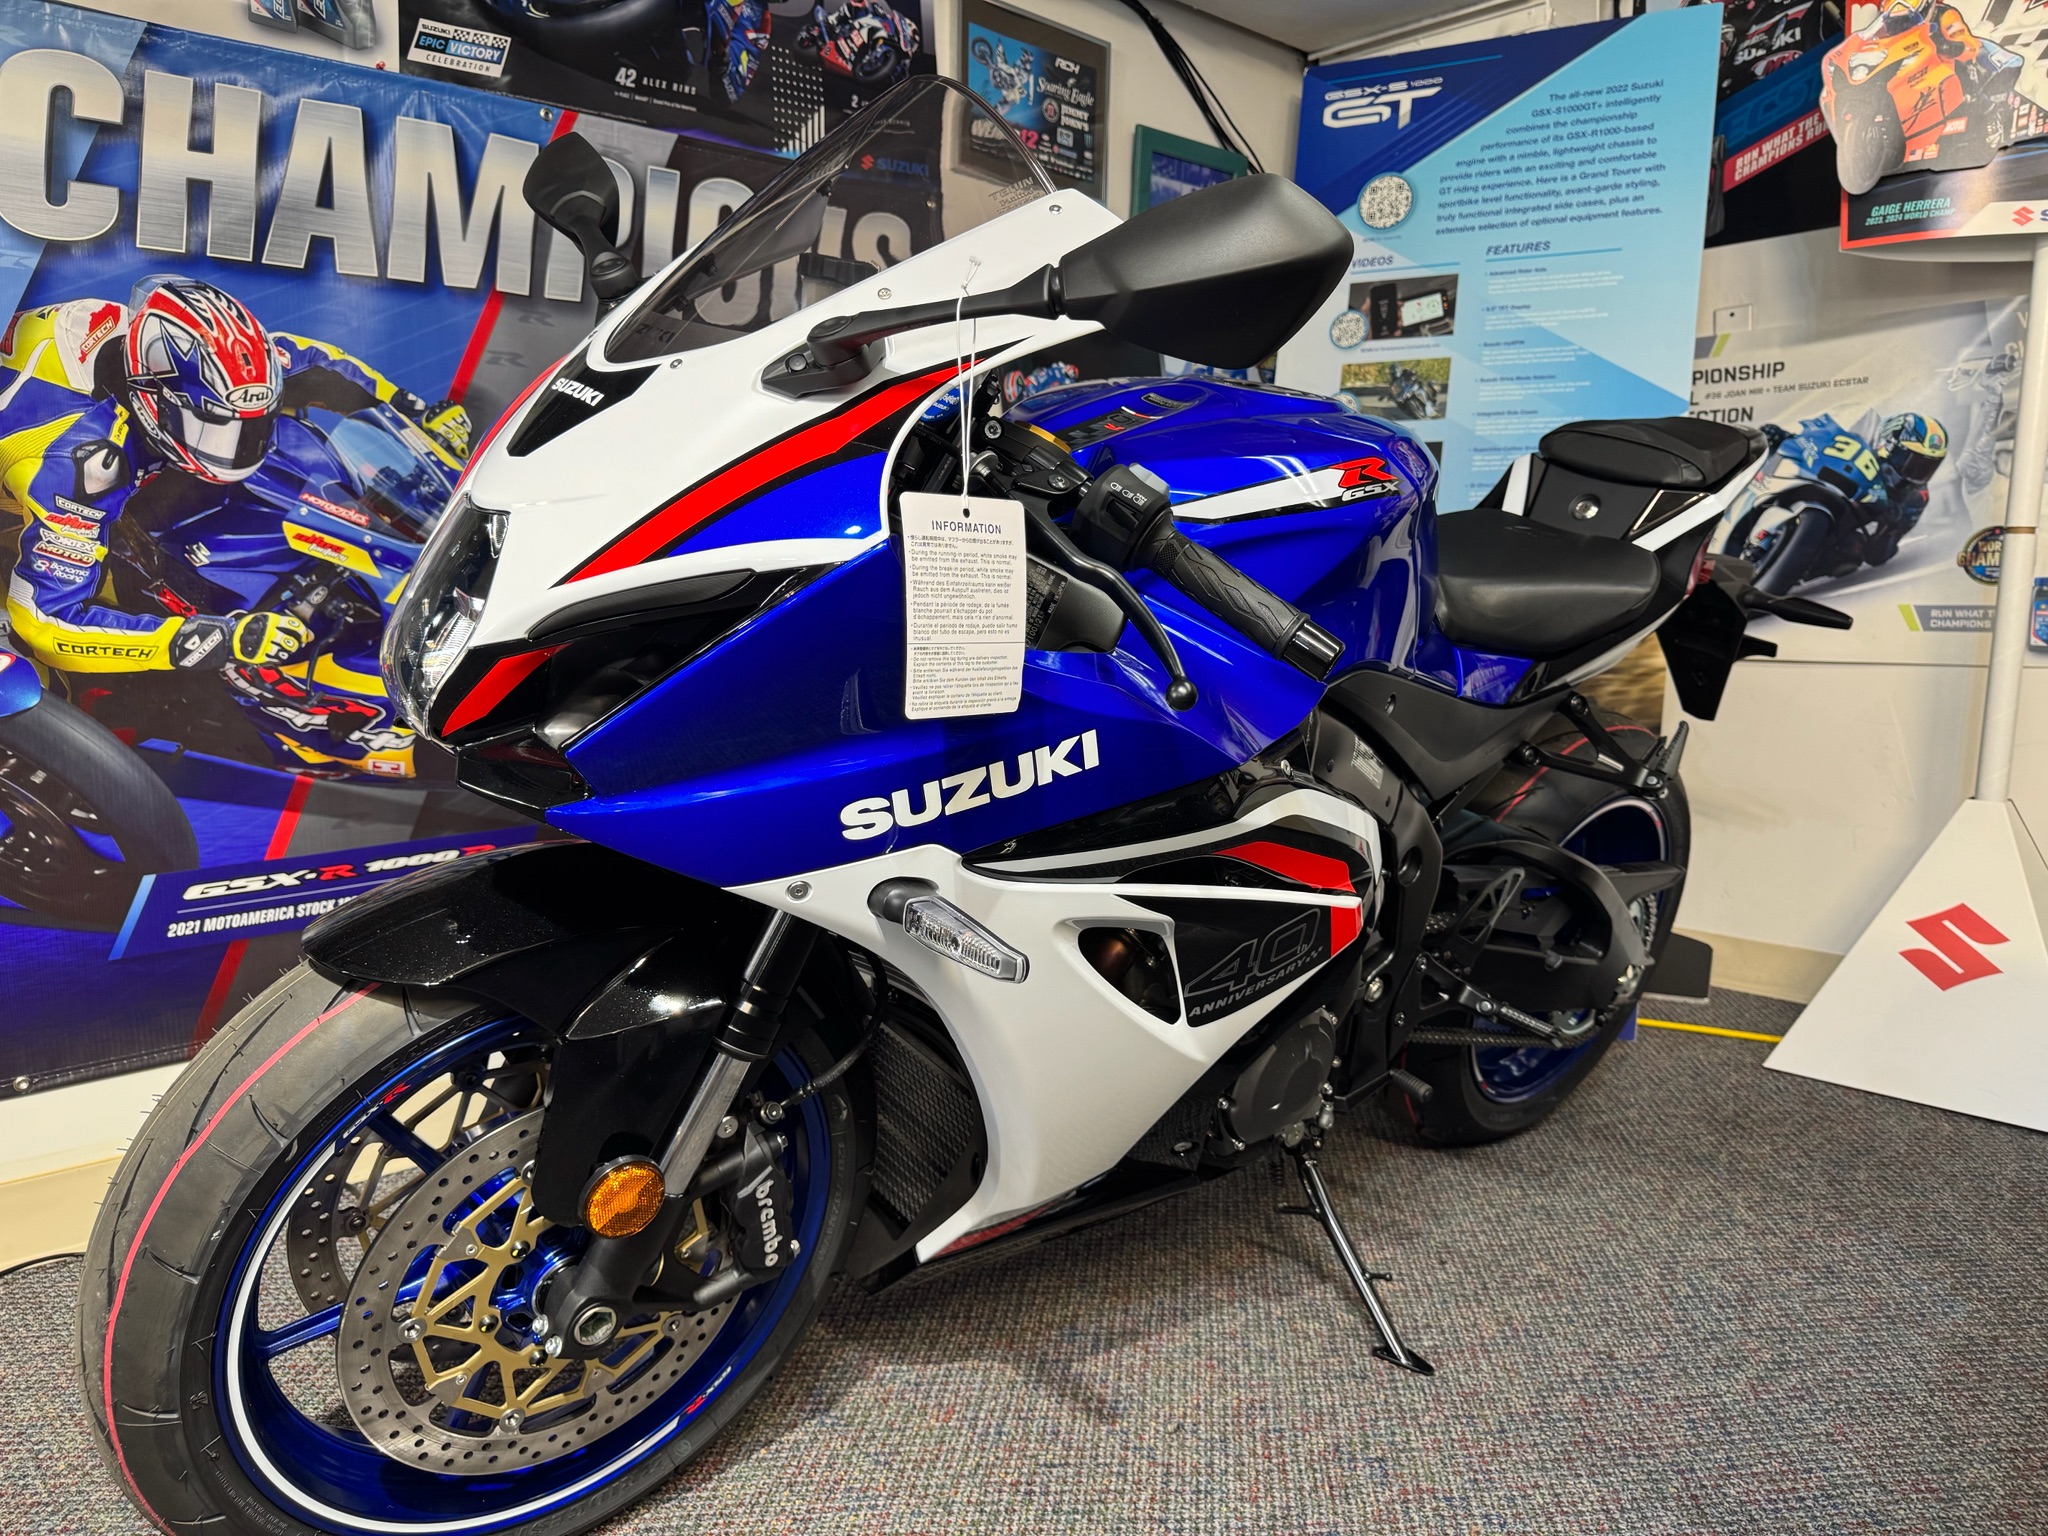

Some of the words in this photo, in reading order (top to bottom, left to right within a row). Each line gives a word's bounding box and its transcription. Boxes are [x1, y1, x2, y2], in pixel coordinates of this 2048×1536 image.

[421, 24, 451, 35] SUZUKI
[419, 35, 446, 50] EPIC
[450, 41, 502, 61] VICTORY
[426, 53, 491, 72] CELEBRATION
[615, 66, 637, 88] 42
[642, 77, 667, 89] ALEX
[1071, 89, 1095, 107] Eagle
[1325, 80, 1408, 101] GSX-S
[1323, 86, 1442, 130] GT
[1020, 129, 1039, 149] 12
[1735, 147, 1760, 170] RUN
[1761, 127, 1796, 155] WHAT
[1798, 112, 1821, 133] THE
[877, 158, 929, 177] SUZUKI
[1734, 135, 1804, 182] CHAMPIONS
[1871, 202, 1902, 217] GAIGE
[1903, 197, 1951, 213] HERRERA
[1904, 211, 1928, 221] WORLD
[1485, 240, 1552, 256] FEATURES
[81, 319, 114, 353] CORTECH
[230, 387, 269, 403] Arai
[551, 378, 605, 407] SUZUKI
[1773, 384, 1796, 394] TEAM
[1799, 381, 1831, 392] SUZUKI
[1833, 377, 1869, 388] ECSTAR
[1823, 434, 1880, 481] 36
[1328, 456, 1398, 488] R
[1341, 481, 1399, 501] GSX
[60, 500, 101, 518] CORTECH
[931, 520, 1002, 535] INFORMATION
[41, 529, 97, 553] VORTEX
[1930, 608, 1953, 618] RUN
[1955, 608, 1983, 618] WHAT
[1930, 619, 1992, 628] CHAMPIONS
[57, 642, 154, 660] CORTECH
[840, 729, 1100, 841] SUZUKI
[182, 864, 357, 900] GSX-R
[364, 849, 461, 872] 1000
[167, 919, 201, 938] 2021
[203, 904, 295, 933] MOTOAMERICA
[296, 898, 336, 917] STOCK
[1184, 908, 1321, 997] 40
[1188, 955, 1309, 1018] ANNIVERSARY
[755, 1178, 783, 1267] brembo
